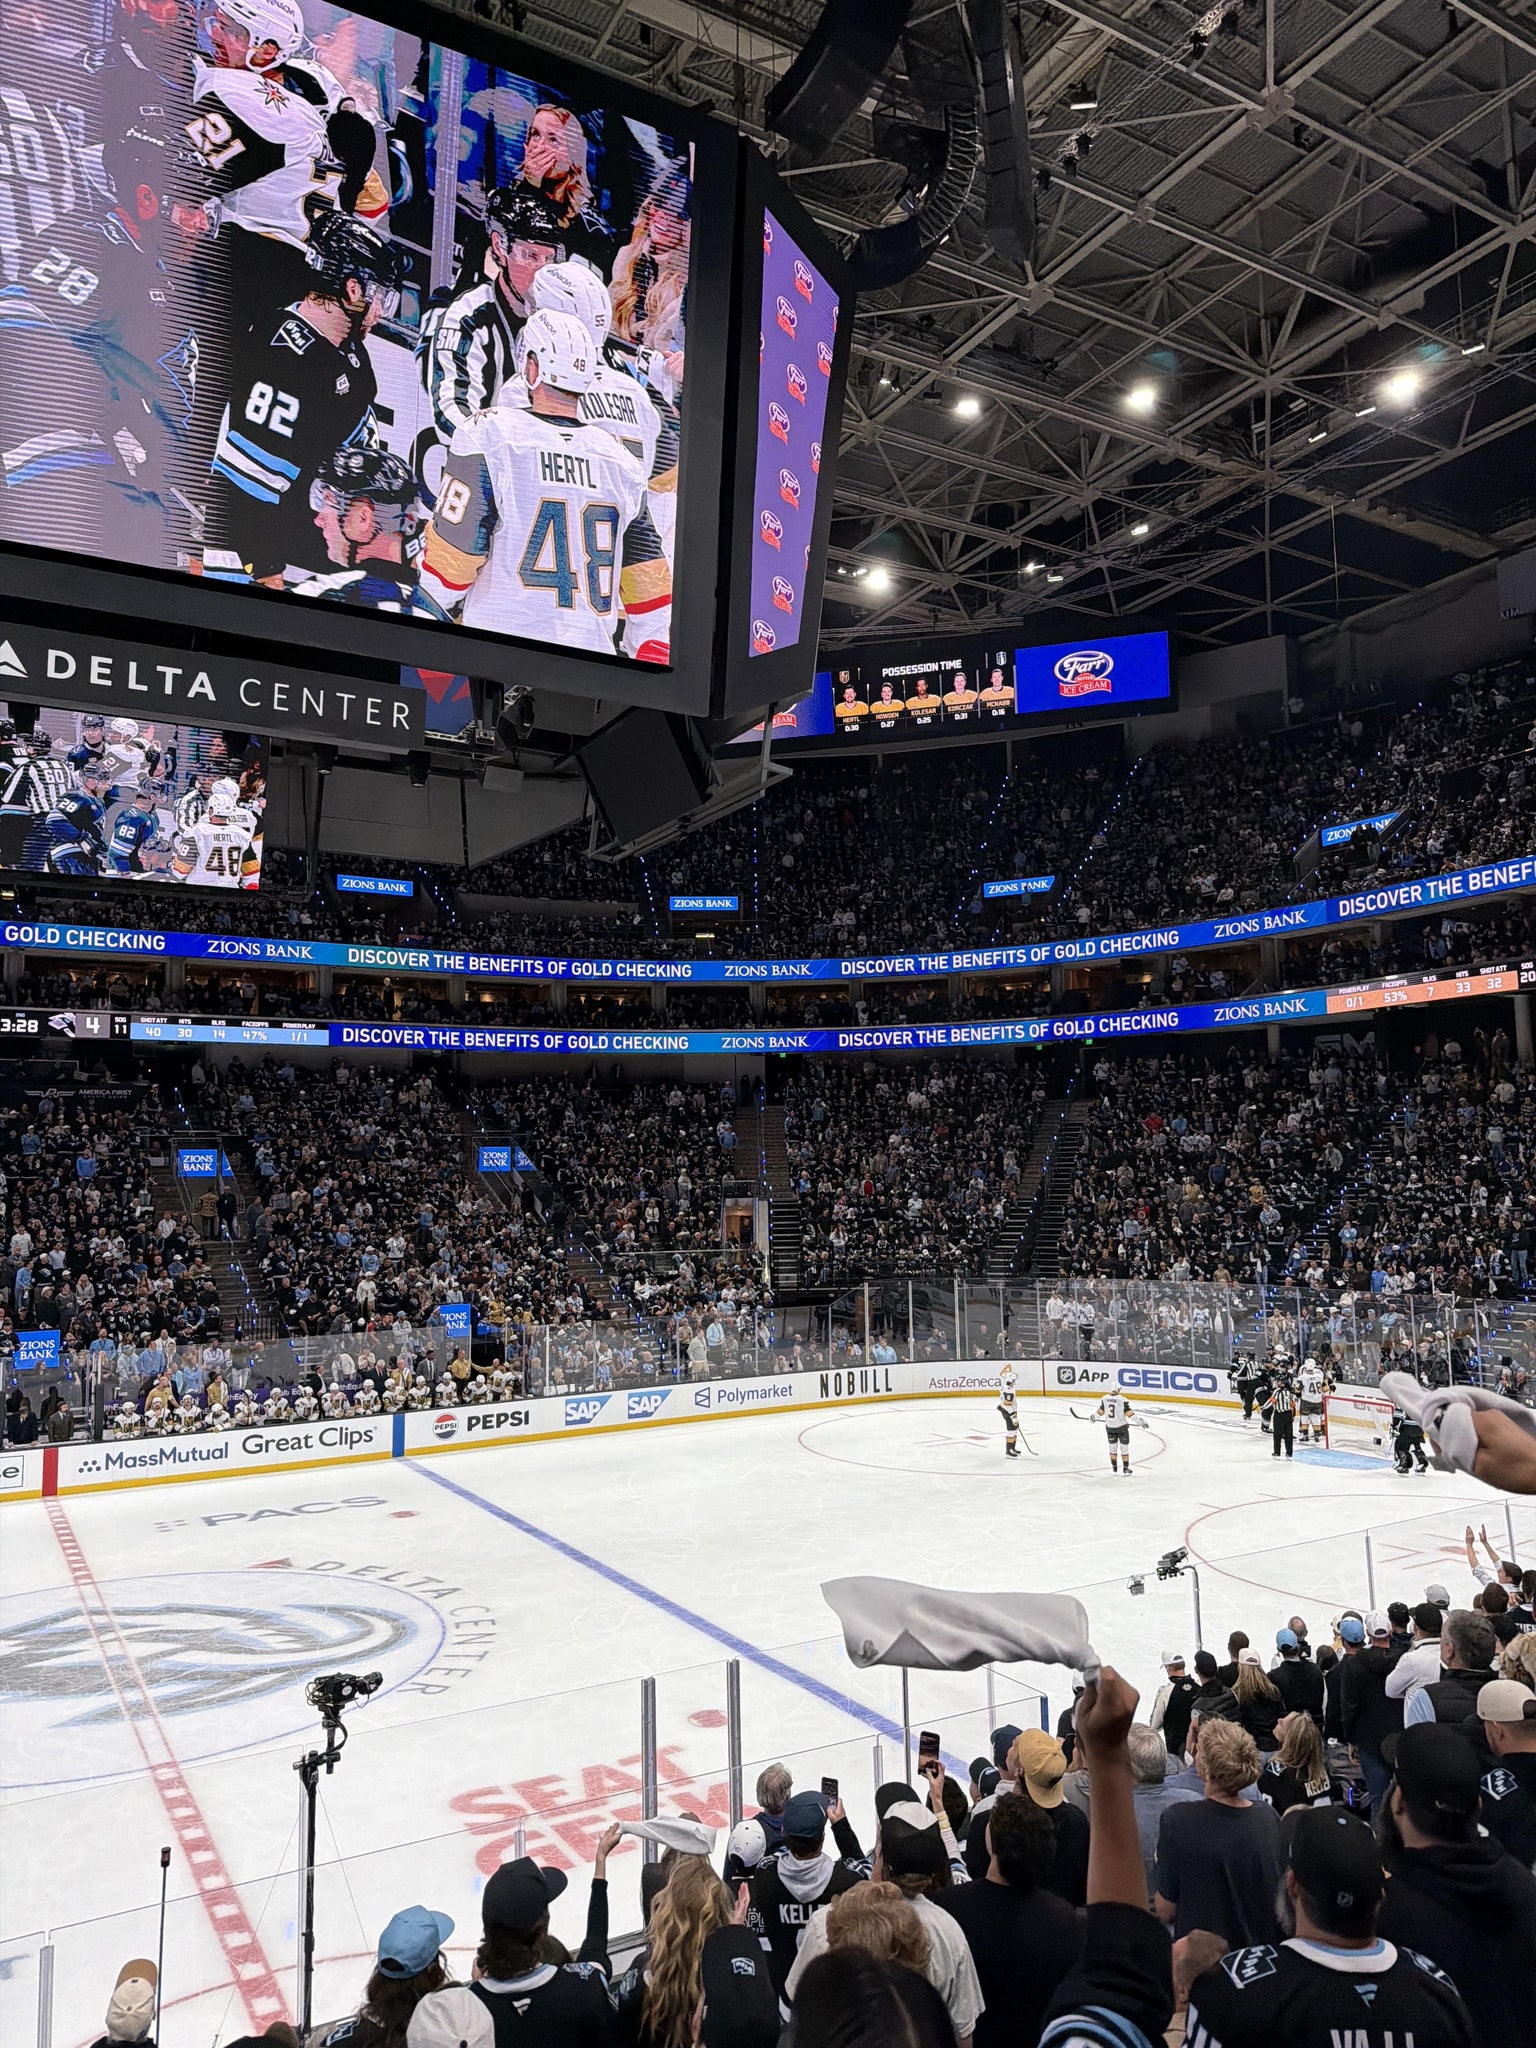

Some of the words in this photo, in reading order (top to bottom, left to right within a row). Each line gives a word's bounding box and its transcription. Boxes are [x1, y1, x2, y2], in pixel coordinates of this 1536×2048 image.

[184, 112, 247, 172] 21
[29, 246, 100, 306] 28
[285, 321, 306, 347] UTAH
[573, 357, 586, 373] 48
[245, 381, 300, 438] 82
[579, 391, 639, 425] KOLESAR
[540, 451, 597, 489] HERTL
[515, 496, 620, 618] 48
[882, 664, 939, 678] POSSESSION
[940, 659, 963, 671] TIME
[1063, 653, 1107, 682] Farr
[46, 648, 218, 702] DELTA
[239, 677, 411, 731] CENTER
[1063, 686, 1077, 694] ICE
[1078, 681, 1108, 693] CREAM
[102, 756, 120, 773] 21
[44, 768, 65, 784] 60
[58, 798, 79, 813] 28
[119, 825, 136, 839] 82
[213, 833, 233, 843] HERTL
[205, 846, 240, 878] 48
[342, 878, 374, 891] ZIONS
[377, 882, 408, 893] BANK
[988, 882, 1018, 895] ZIONS
[674, 899, 704, 909] ZIONS
[705, 900, 733, 909] BANK
[1338, 884, 1423, 917] DISCOVER
[1426, 875, 1463, 899] THE
[1213, 918, 1260, 939] ZIONS
[1263, 909, 1308, 930] BANK
[5, 925, 60, 944] GOLD
[66, 929, 166, 951] CHECKING
[207, 939, 261, 956] ZIONS
[265, 944, 316, 960] BANK
[841, 958, 915, 975] DISCOVER
[918, 955, 949, 970] THE
[952, 949, 1027, 969] BENEFITS
[1030, 946, 1050, 960] OF
[1054, 940, 1097, 959] GOLD
[1099, 930, 1180, 954] CHECKING
[348, 947, 430, 968] DISCOVER
[433, 953, 465, 970] THE
[468, 956, 544, 974] BENEFITS
[548, 960, 568, 975] OF
[571, 962, 612, 977] GOLD
[616, 963, 692, 979] CHECKING
[724, 965, 768, 977] ZIONS
[771, 964, 812, 976] BANK
[1487, 978, 1502, 989] 32
[1520, 971, 1536, 984] 20
[1427, 986, 1434, 997] 7
[1455, 981, 1471, 993] 33
[1346, 996, 1363, 1008] 0/1
[1384, 991, 1408, 1003] 53%
[1213, 1003, 1260, 1022] ZIONS
[1263, 998, 1308, 1015] BANK
[0, 1018, 39, 1033] 3:28
[85, 1016, 101, 1034] 4
[114, 1024, 127, 1034] 11
[145, 1027, 161, 1037] 40
[177, 1028, 192, 1038] 30
[212, 1029, 225, 1038] 14
[838, 1031, 913, 1047] DISCOVER
[916, 1029, 947, 1044] THE
[951, 1024, 1025, 1042] BENEFITS
[1028, 1022, 1049, 1038] OF
[1053, 1019, 1095, 1036] GOLD
[1099, 1011, 1179, 1033] CHECKING
[243, 1030, 268, 1041] 47%
[290, 1032, 308, 1042] 1/1
[342, 1027, 425, 1045] DISCOVER
[428, 1031, 460, 1046] THE
[463, 1032, 540, 1049] BENEFITS
[543, 1035, 563, 1049] OF
[567, 1036, 609, 1050] GOLD
[612, 1036, 689, 1051] CHECKING
[721, 1037, 765, 1048] ZIONS
[769, 1036, 809, 1047] BANK
[183, 1154, 214, 1163] ZIONS
[183, 1162, 213, 1172] BANK
[446, 1320, 467, 1329] ANK
[20, 1340, 56, 1351] ZIONS
[20, 1349, 55, 1360] BANK
[820, 1368, 893, 1398] NOBULL
[928, 1375, 1002, 1390] AstraZeneca
[1117, 1368, 1218, 1393] GEICO
[717, 1384, 793, 1405] Polymarket
[565, 1401, 601, 1421] SAP
[627, 1395, 662, 1414] SAP
[1108, 1404, 1116, 1418] 3
[467, 1409, 530, 1431] PEPSI
[242, 1432, 313, 1455] Great
[318, 1427, 374, 1450] Clips
[105, 1441, 229, 1471] MassMutual
[201, 1496, 388, 1527] PACS
[306, 1560, 463, 1600] DELTA
[400, 1605, 497, 1696] CENTER
[448, 1745, 694, 1836] SEAT
[779, 1903, 827, 1924] KELL
